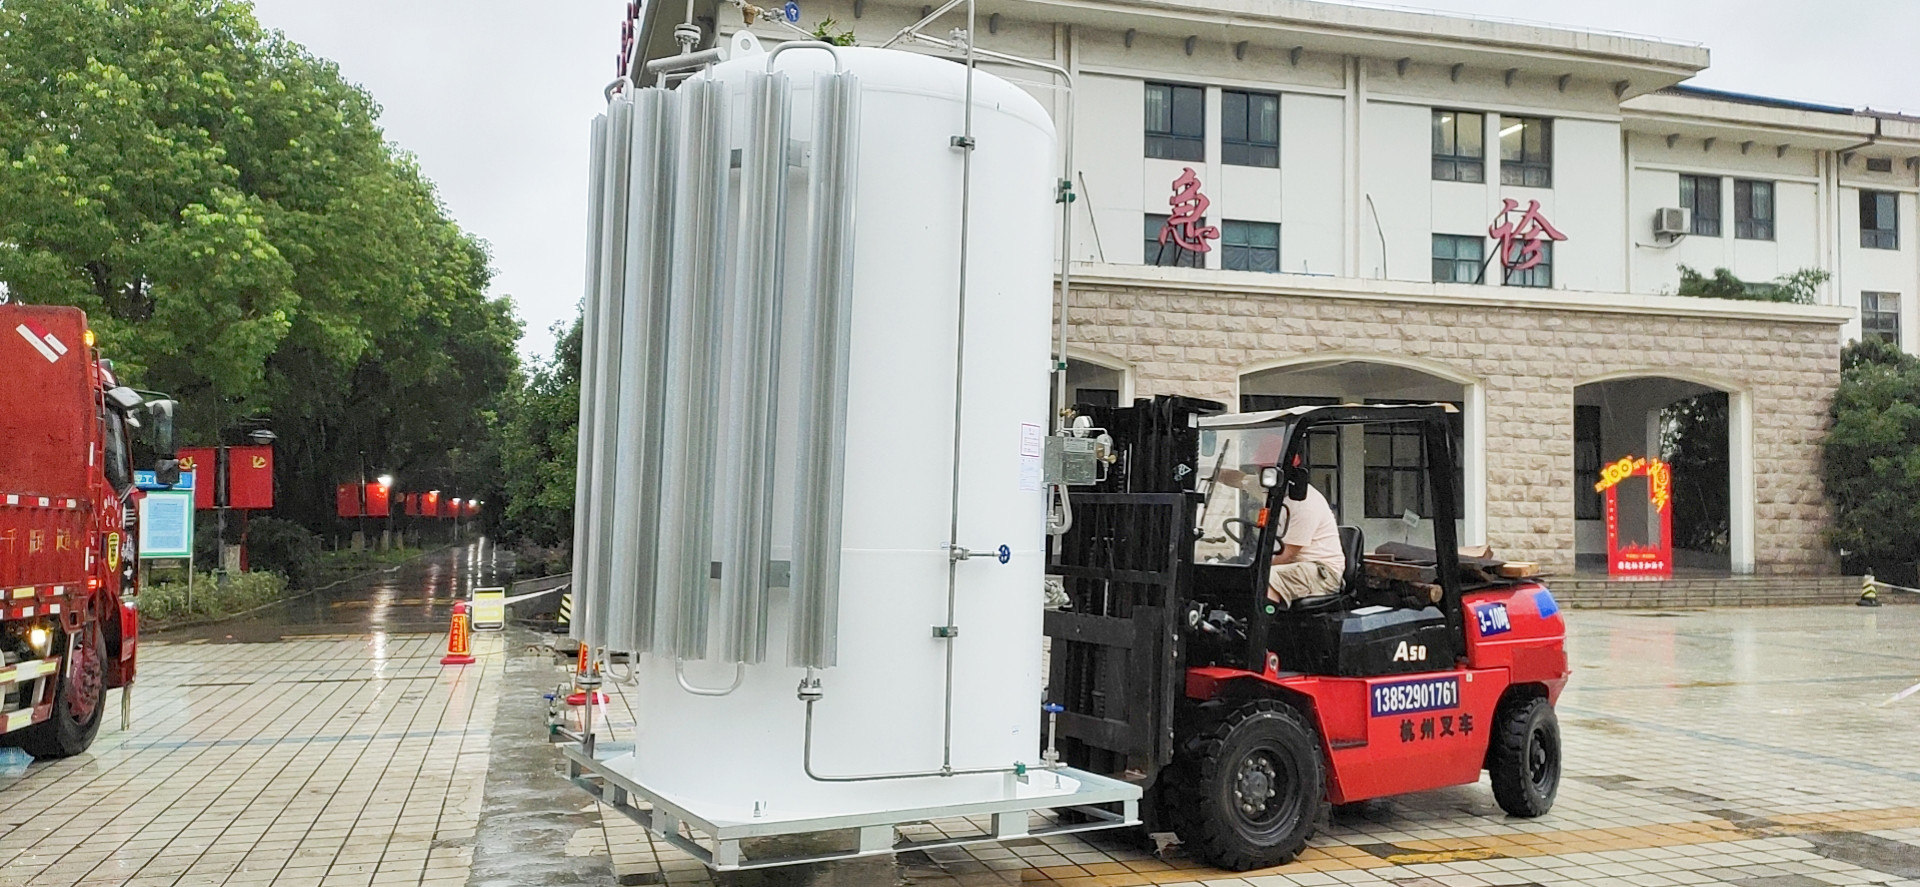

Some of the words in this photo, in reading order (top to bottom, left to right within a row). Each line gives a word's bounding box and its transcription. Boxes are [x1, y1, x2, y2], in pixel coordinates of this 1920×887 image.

[1374, 680, 1458, 713] 13852901761
[1400, 712, 1474, 743] 杭州叉车
